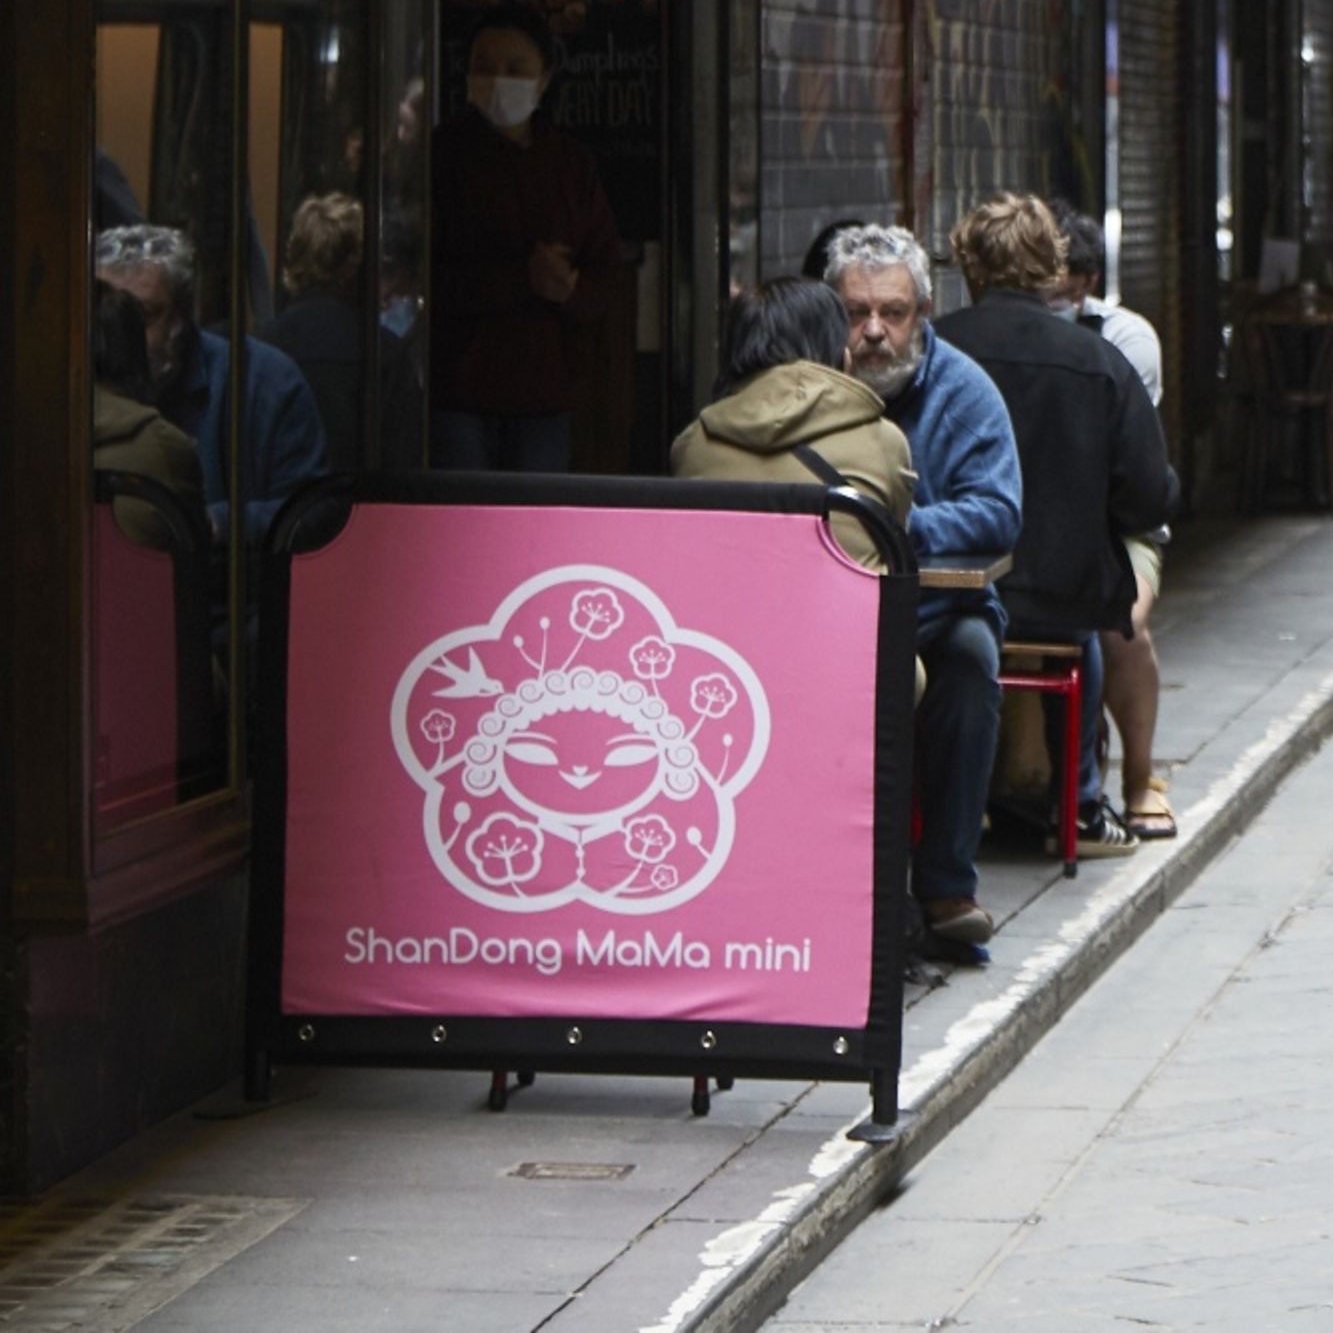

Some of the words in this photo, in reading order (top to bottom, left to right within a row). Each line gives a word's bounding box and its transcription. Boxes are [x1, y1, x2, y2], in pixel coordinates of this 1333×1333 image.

[344, 925, 564, 975] ShanDong
[575, 929, 712, 969] MaMa
[725, 937, 813, 974] mini
